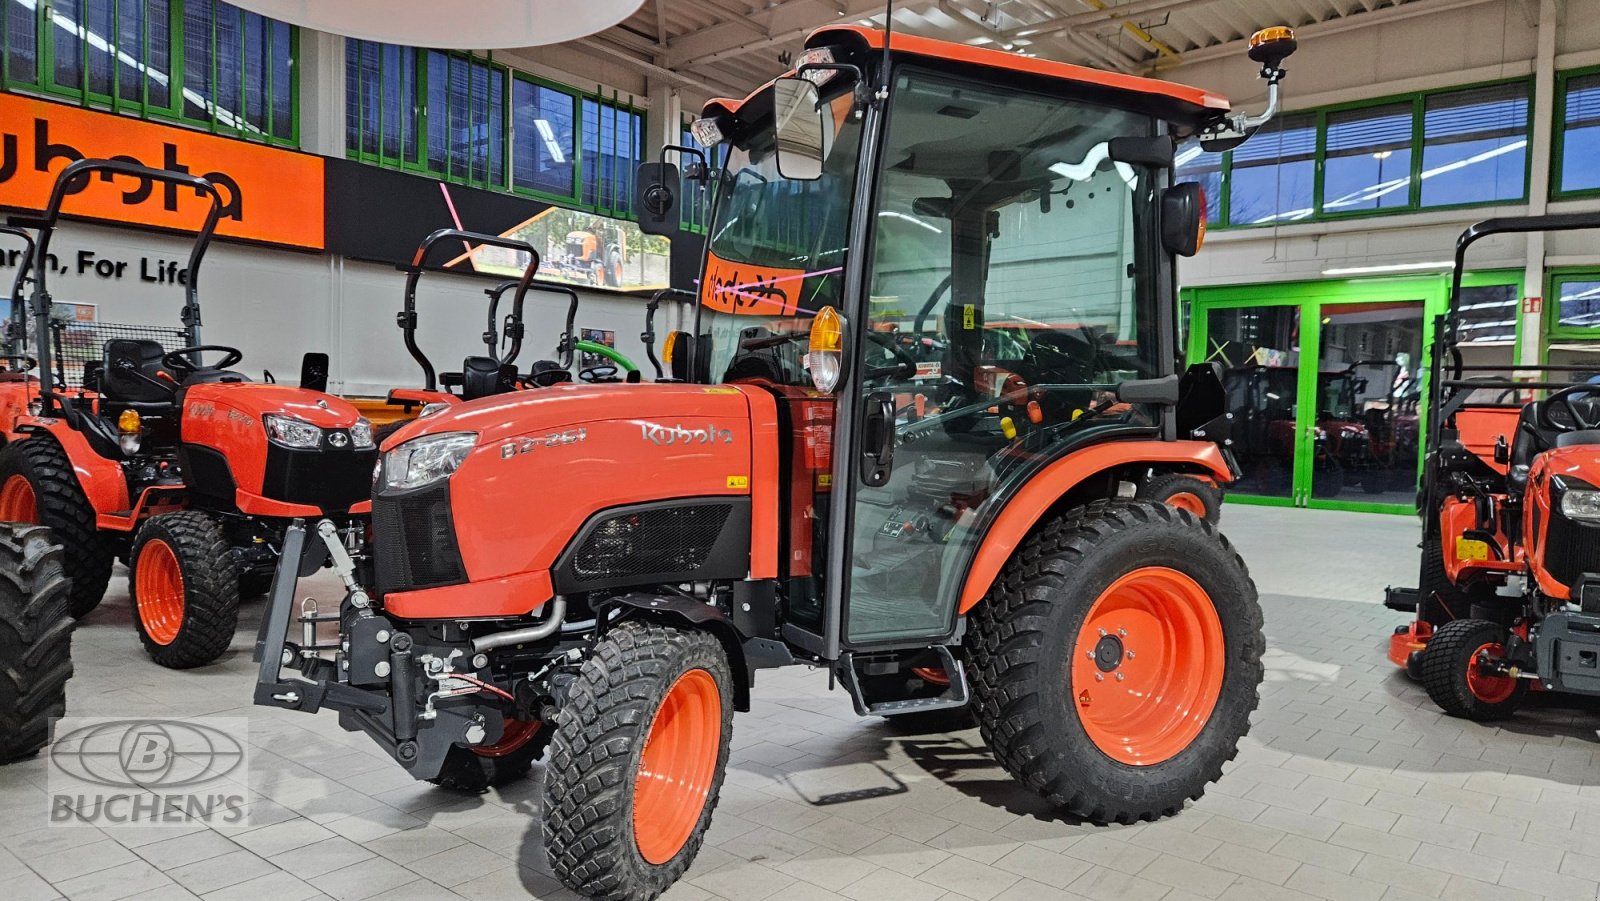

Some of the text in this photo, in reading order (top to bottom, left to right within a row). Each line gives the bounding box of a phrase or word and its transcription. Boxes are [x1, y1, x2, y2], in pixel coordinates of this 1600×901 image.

[77, 251, 127, 278] For
[141, 257, 188, 284] Life
[641, 423, 733, 446] Kubota
